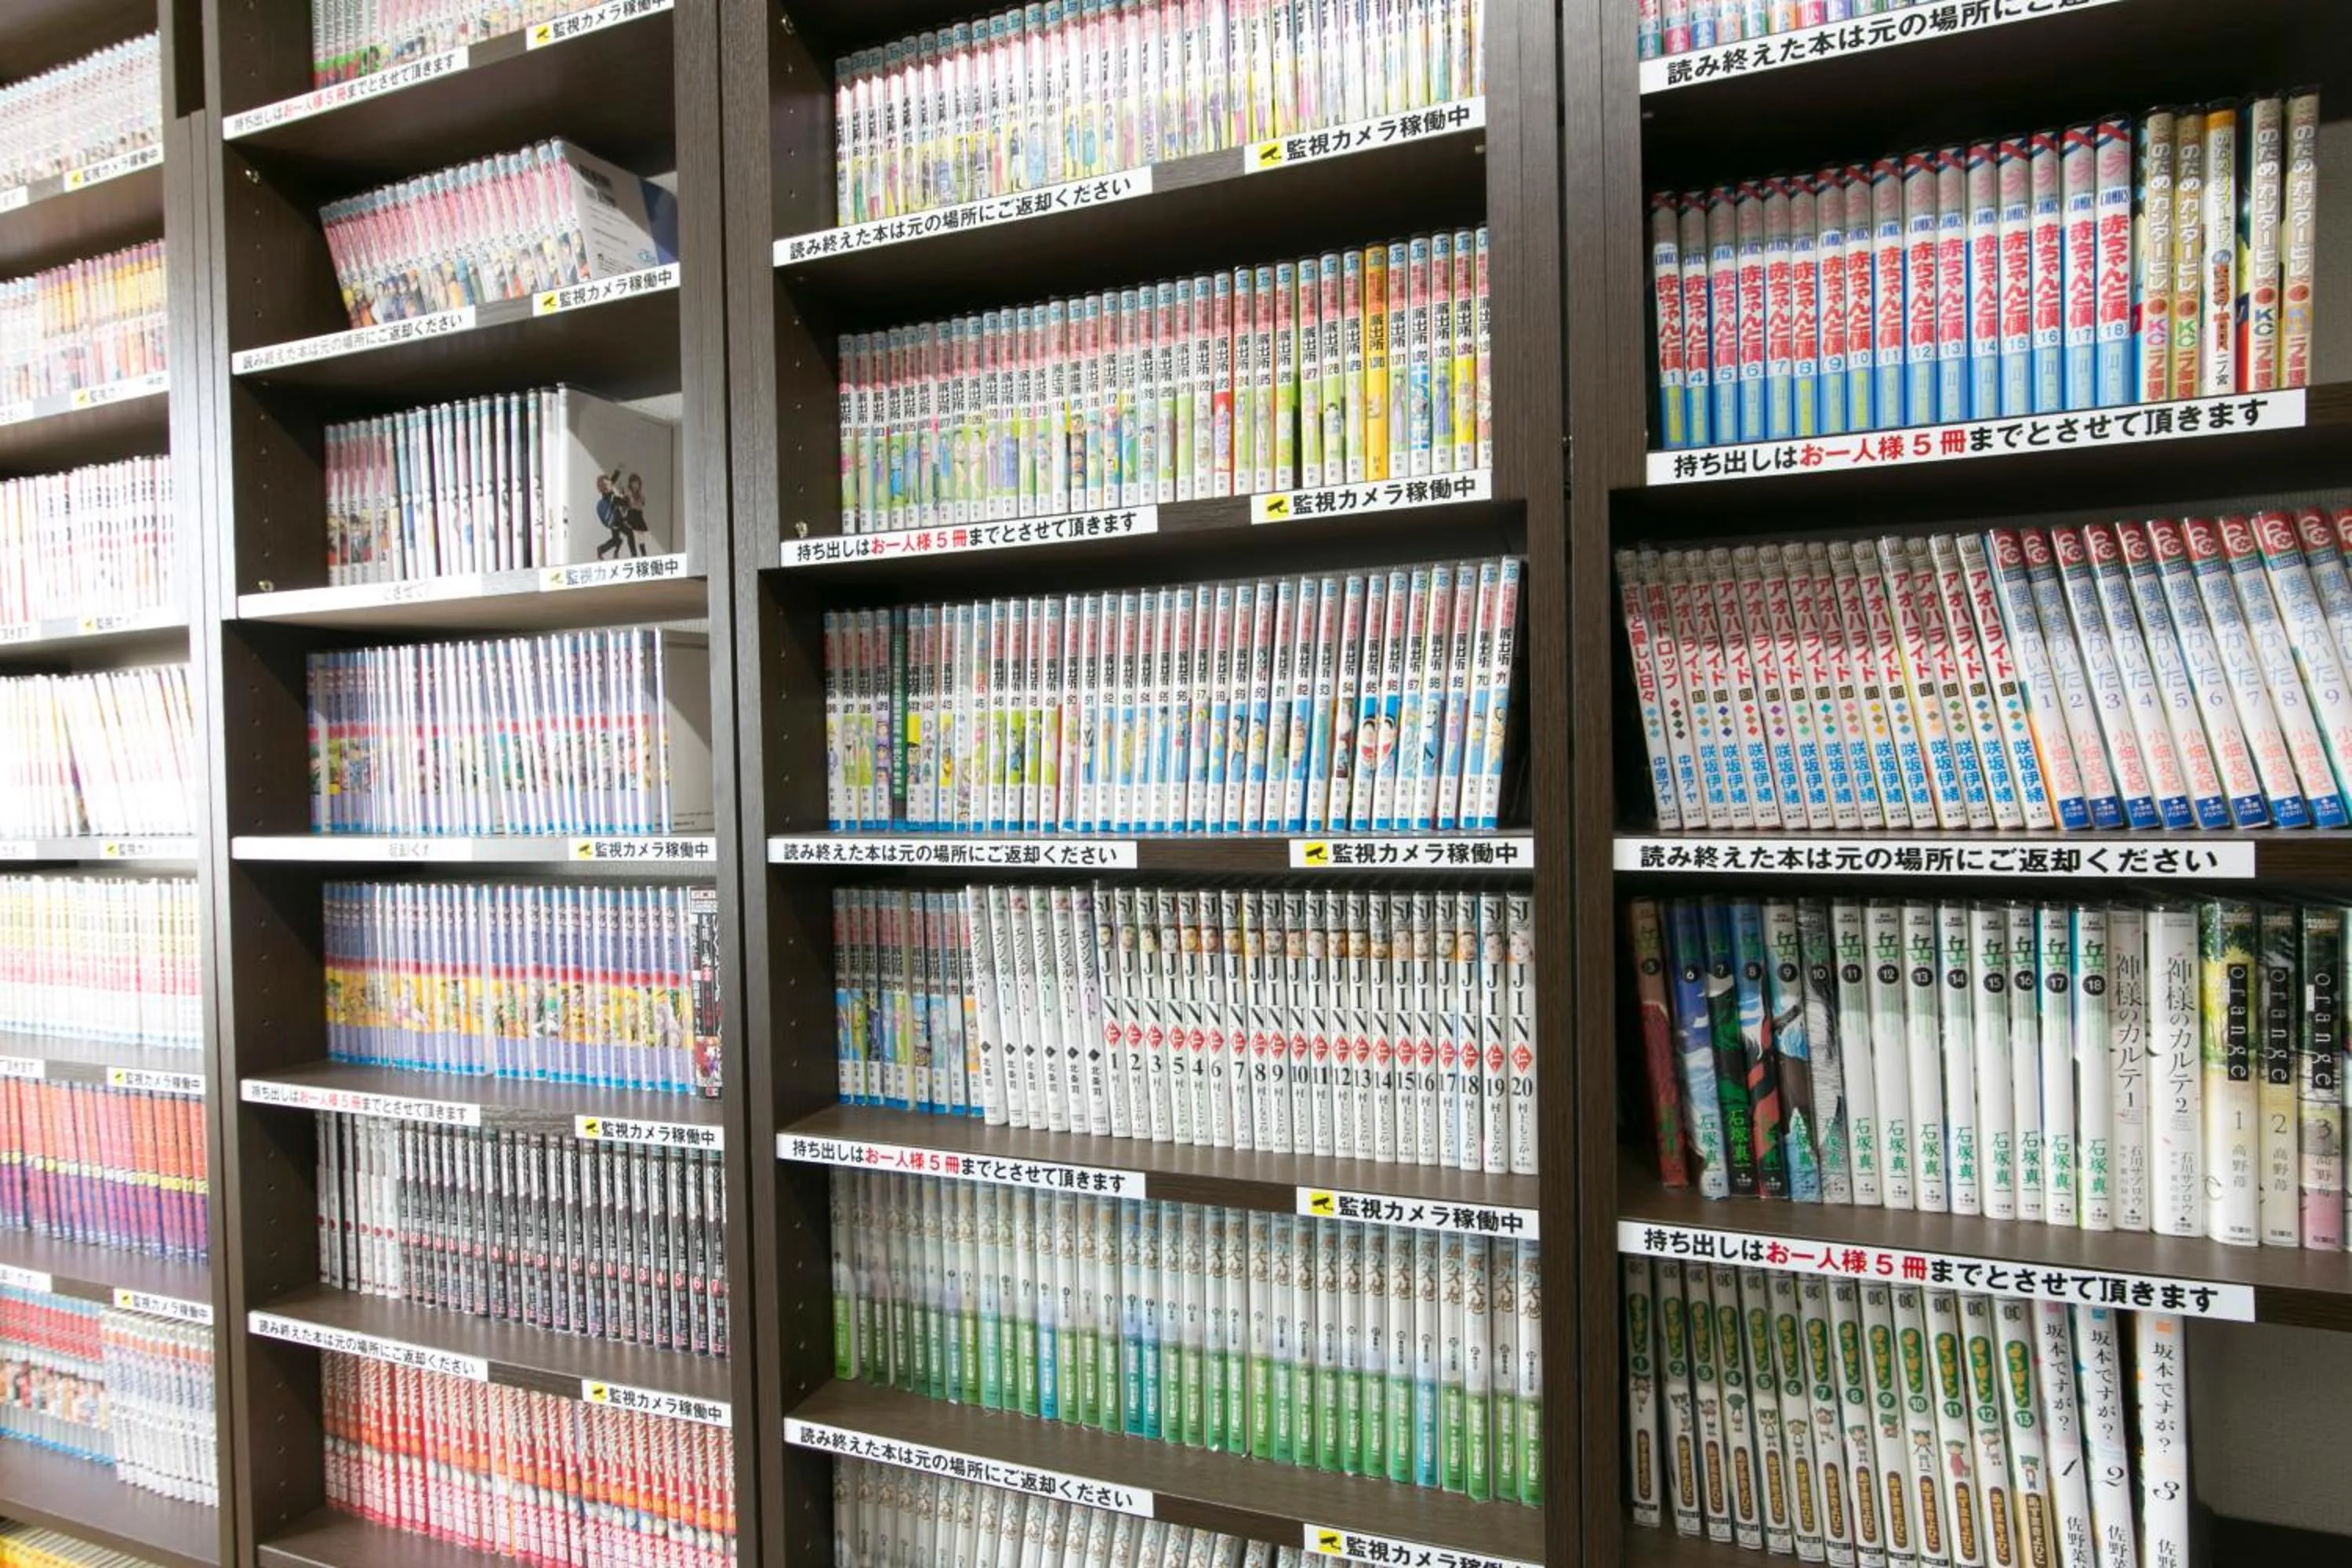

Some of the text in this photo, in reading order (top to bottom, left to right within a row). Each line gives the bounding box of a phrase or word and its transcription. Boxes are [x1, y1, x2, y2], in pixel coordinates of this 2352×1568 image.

[1287, 106, 1470, 161] 監視カメラ稼働中
[789, 176, 1131, 260] 読み終えた本は元の場所にご返却ください
[2101, 214, 2129, 323] 赤ちゃんと僕
[560, 270, 673, 309] 監視カメラ稼働中
[1675, 400, 2268, 478] 持ち出しはお一人様5冊までとさせて頂きます
[1294, 477, 1475, 515] 監視カメラ稼働中
[797, 511, 1137, 562] 持ち出しはお一人様5冊までとさせて頂きます
[1717, 582, 1751, 685] アオハライド
[1741, 581, 1780, 685] アオハライド
[1766, 579, 1802, 685] アオハライド
[1815, 577, 1851, 683] アオハライド
[1837, 575, 1876, 683] アオハライド
[1859, 575, 1902, 683] アオハライド
[1894, 571, 1931, 680] アオハライド
[1944, 569, 1983, 680] アオハライド
[1969, 568, 2013, 679] アオハライド
[2042, 693, 2053, 708] 1
[2070, 693, 2083, 709] 2
[2105, 692, 2120, 710] 3
[2139, 692, 2153, 708] 4
[2174, 691, 2189, 708] 5
[2209, 689, 2223, 706] 6
[2245, 690, 2259, 706] 7
[2281, 690, 2297, 706] 8
[2324, 688, 2340, 706] 9
[595, 843, 710, 859] 監視カメラ稼働中
[784, 842, 1117, 865] 読み終えた本は元の場所にご返却ください
[1333, 842, 1518, 864] 監視カメラ稼働中
[1641, 846, 2217, 873] 読み終えた本は元の場所にご返却ください
[2115, 954, 2145, 1090] 神様のカルテ
[2167, 956, 2195, 1092] 神様のカルテ
[2267, 967, 2290, 1084] orange
[2311, 971, 2333, 1089] orange
[1129, 1053, 1142, 1070] 2
[1172, 1056, 1185, 1075] 5
[2227, 966, 2249, 1131] orange 1
[1233, 1061, 1245, 1079] 7
[1254, 1062, 1267, 1082] 8
[1272, 1064, 1284, 1082] 9
[1334, 1067, 1351, 1086] 12
[1397, 1072, 1416, 1091] 15
[1417, 1073, 1435, 1092] 16
[1461, 1075, 1479, 1095] 18
[1486, 1078, 1505, 1098] 19
[1512, 1076, 1533, 1097] 20
[2174, 1098, 2188, 1114] 2
[2271, 1114, 2288, 1135] 2
[601, 1122, 717, 1146] 監視カメラ稼働中
[793, 1138, 1126, 1192] 持ち出しはお一人様5冊までとさせて頂きます
[1339, 1196, 1523, 1233] 監視カメラ稼働中
[1644, 1228, 2218, 1313] 持ち出しはお一人様5冊までとさせて頂きます
[258, 1319, 475, 1376] 読み終えた本は元の場所にご返却ください
[2045, 1323, 2072, 1432] 坂本ですが?
[608, 1387, 724, 1422] 監視カメラ稼働中
[2091, 1329, 2125, 1488] 坂本ですが? 2
[2152, 1341, 2180, 1501] 坂本ですが? 3
[800, 1427, 1133, 1508] 読み終えた本は元の場所にご返却ください
